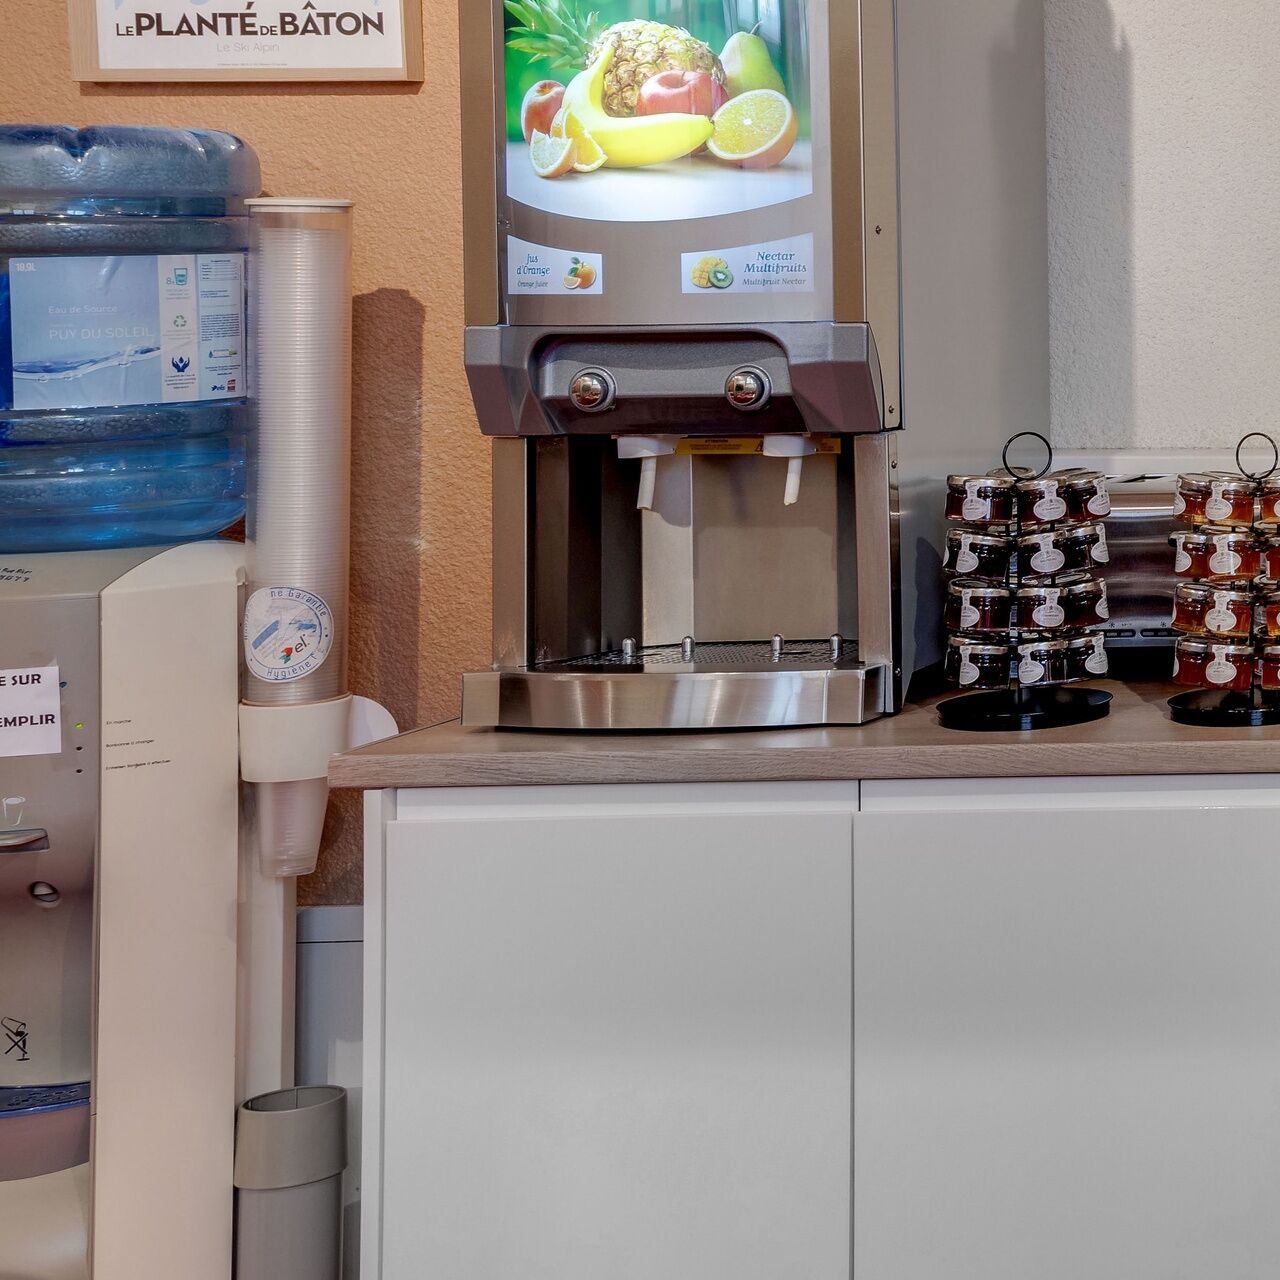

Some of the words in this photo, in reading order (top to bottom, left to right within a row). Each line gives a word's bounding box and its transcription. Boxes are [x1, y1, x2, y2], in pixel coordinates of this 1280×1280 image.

[135, 1, 259, 36] PLANTÉ
[260, 25, 278, 36] DE
[280, 0, 384, 36] BÂTON
[756, 251, 795, 261] Nectar
[516, 265, 550, 277] d'Orange
[743, 263, 807, 274] Multifruits
[11, 673, 42, 686] SUR
